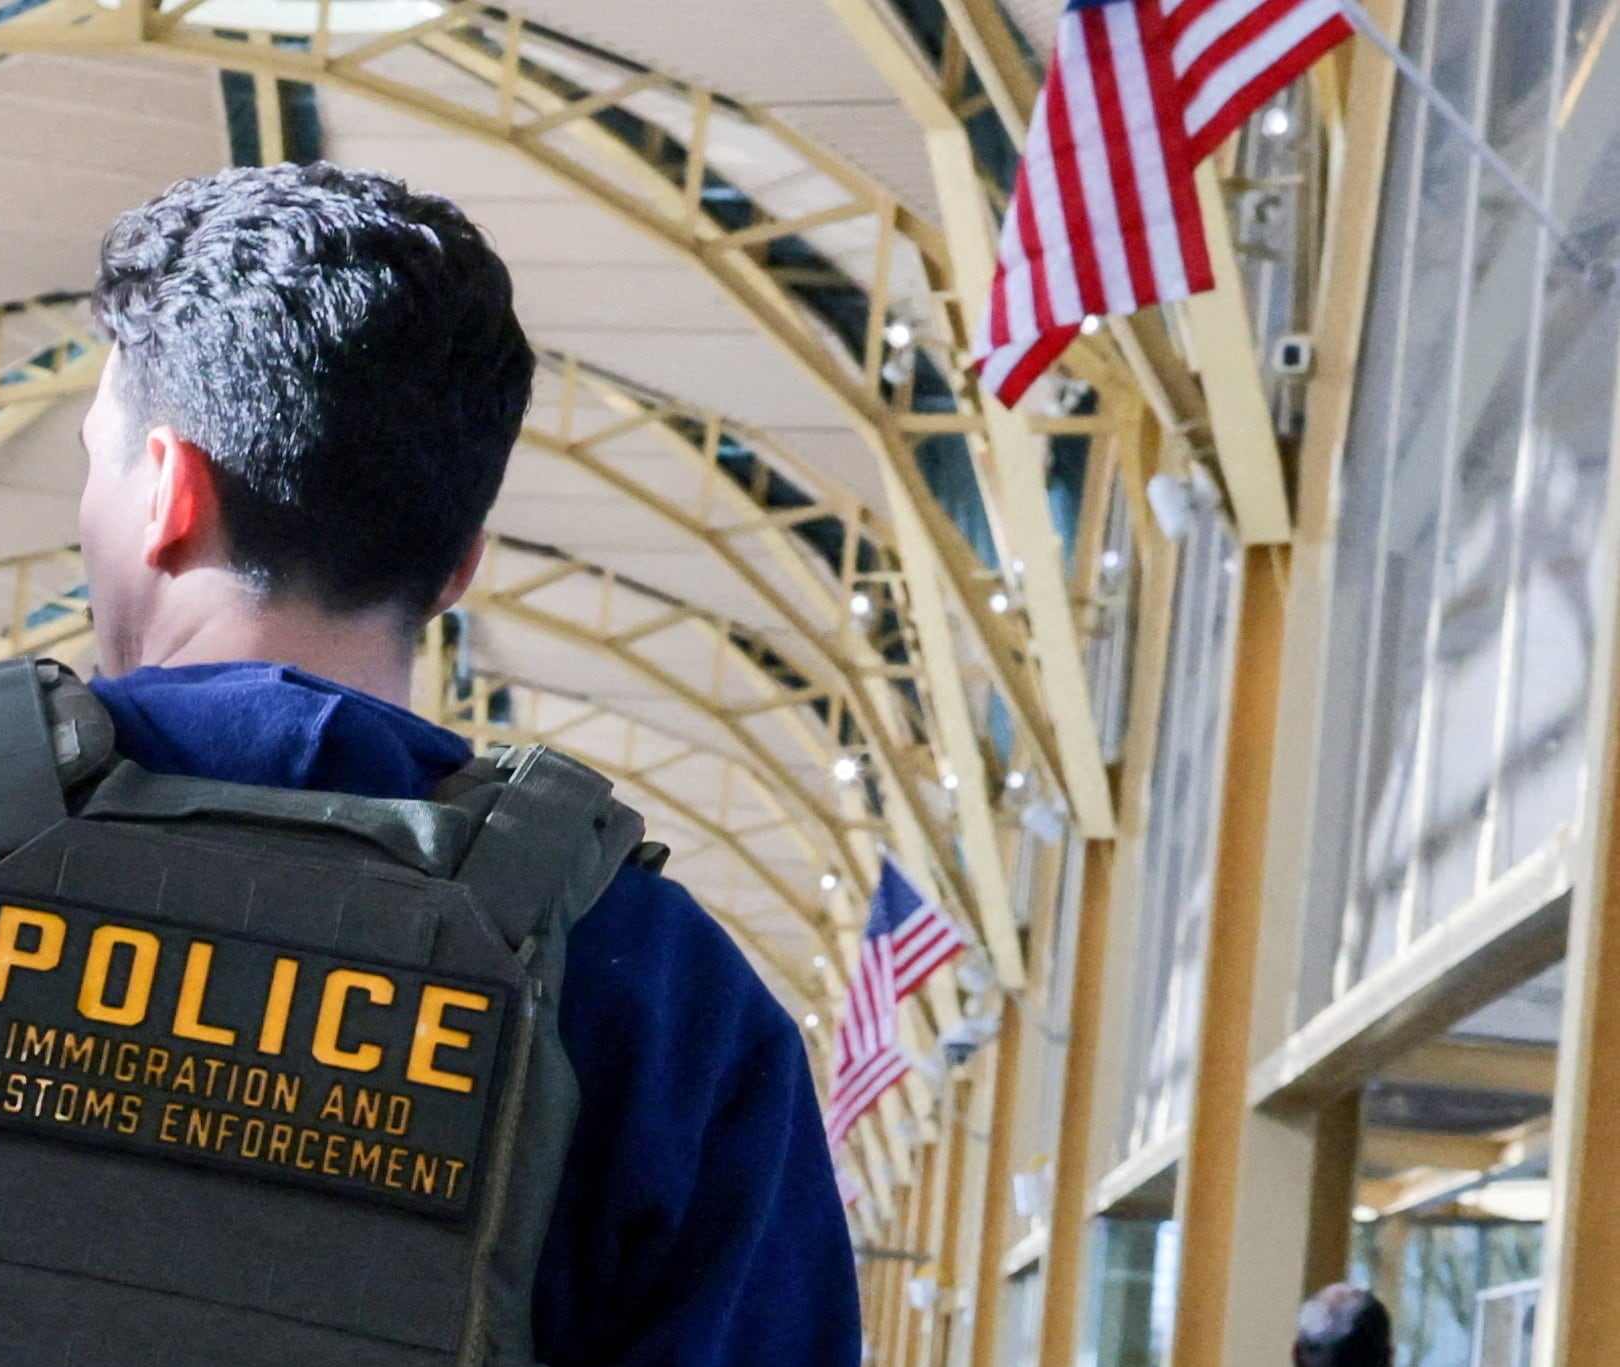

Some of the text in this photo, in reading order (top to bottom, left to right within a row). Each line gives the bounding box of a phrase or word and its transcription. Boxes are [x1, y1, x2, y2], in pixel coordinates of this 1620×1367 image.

[4, 1021, 412, 1137] IMMIGRATION AND
[160, 1102, 464, 1199] ENFORCEMENT
